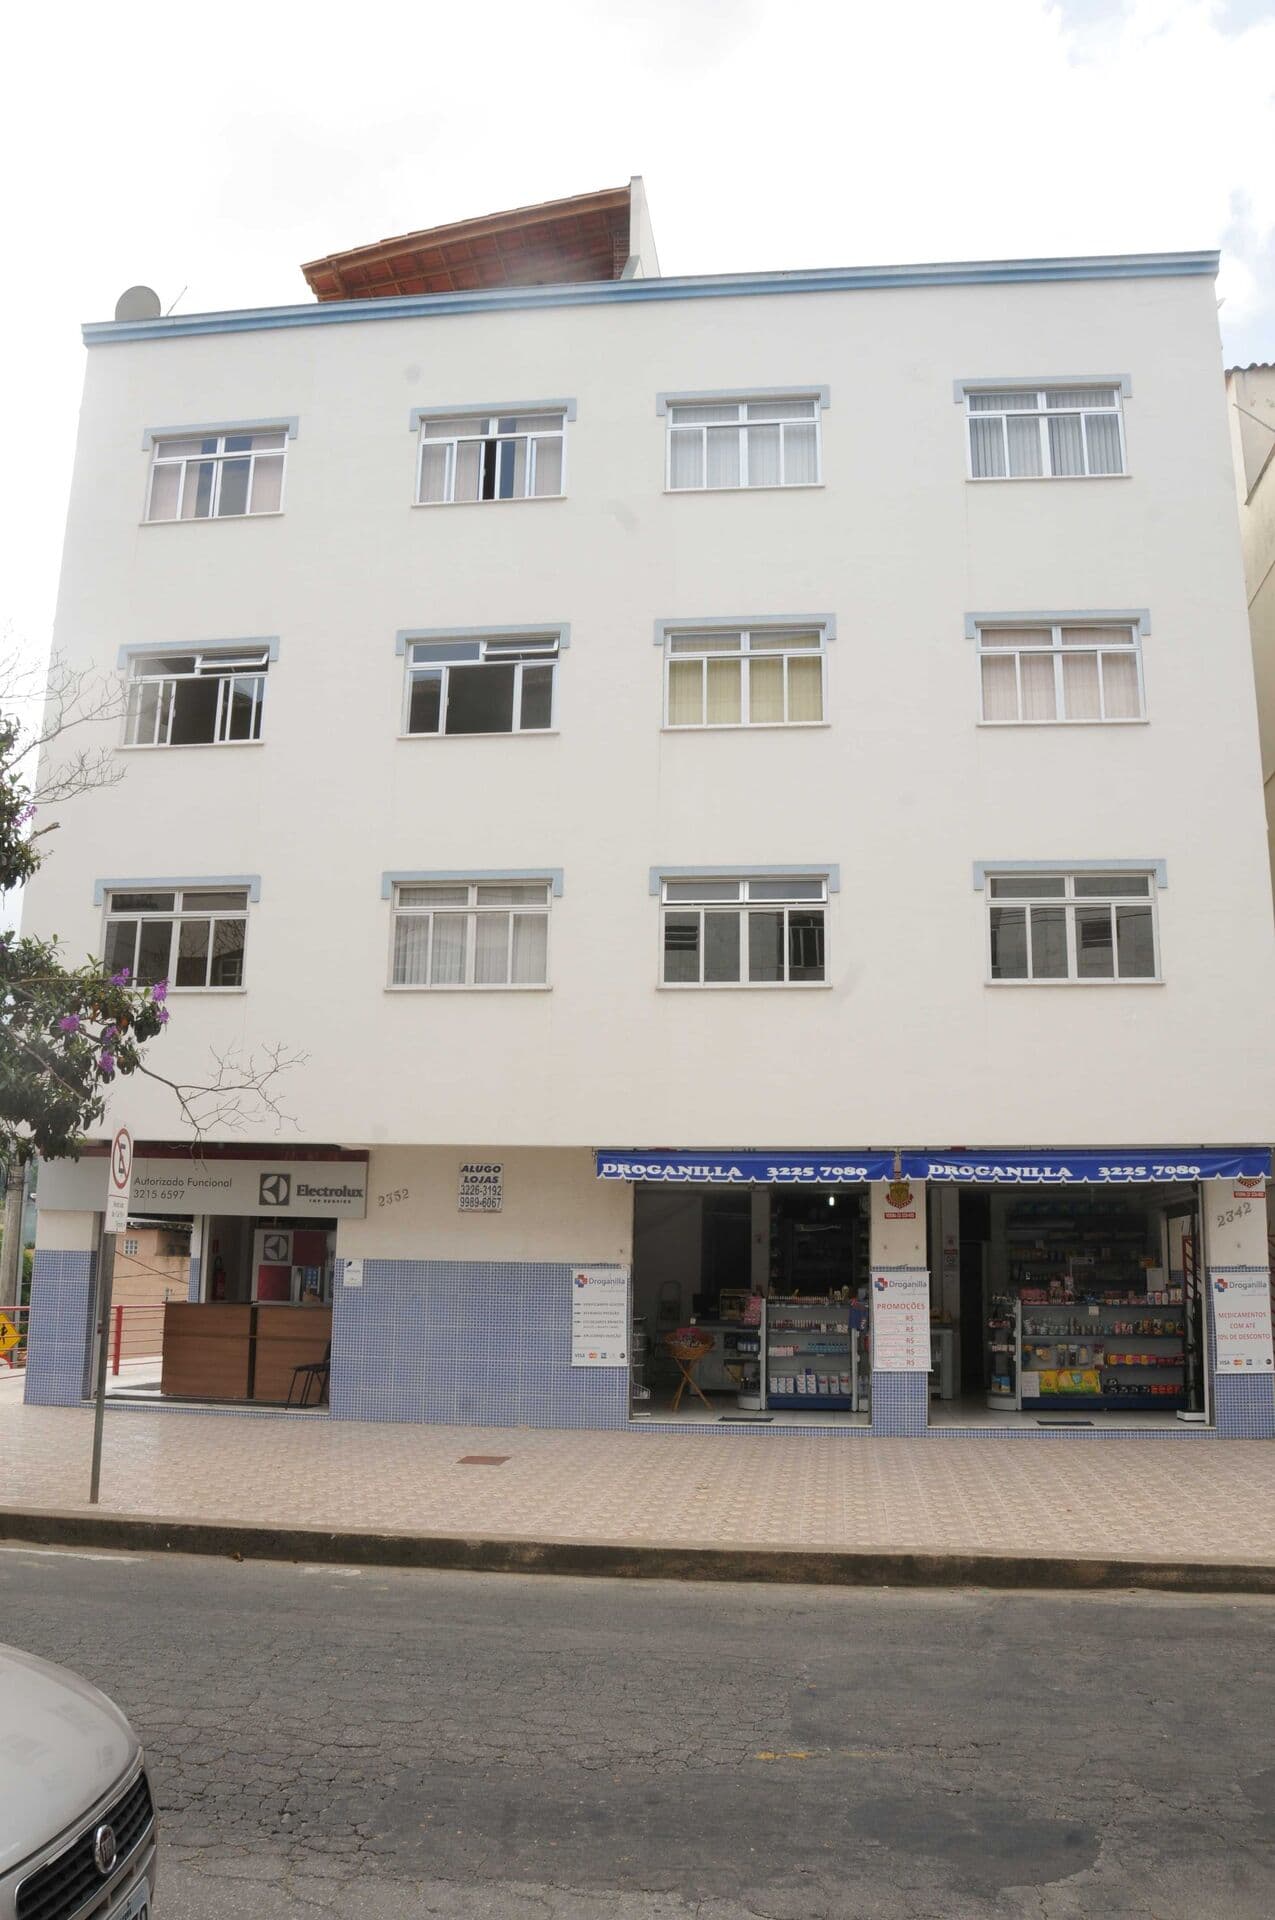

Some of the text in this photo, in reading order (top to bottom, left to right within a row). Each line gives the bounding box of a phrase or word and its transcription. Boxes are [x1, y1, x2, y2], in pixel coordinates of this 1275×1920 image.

[461, 1165, 501, 1173] ALUGO
[602, 1163, 868, 1177] DROGANILLA 3225 7080
[928, 1164, 1201, 1177] DROGANILLA 3225 7080
[134, 1177, 232, 1188] Autorizado Funcional
[464, 1175, 498, 1184] LOJAS
[133, 1189, 185, 1200] 3215 6597
[296, 1184, 364, 1198] Electrolux
[1217, 1202, 1252, 1228] 2342
[589, 1277, 626, 1287] Droganilla
[889, 1280, 927, 1289] Droganilla
[1229, 1280, 1267, 1290] Droganilla
[877, 1302, 926, 1311] PROMOÇÕES
